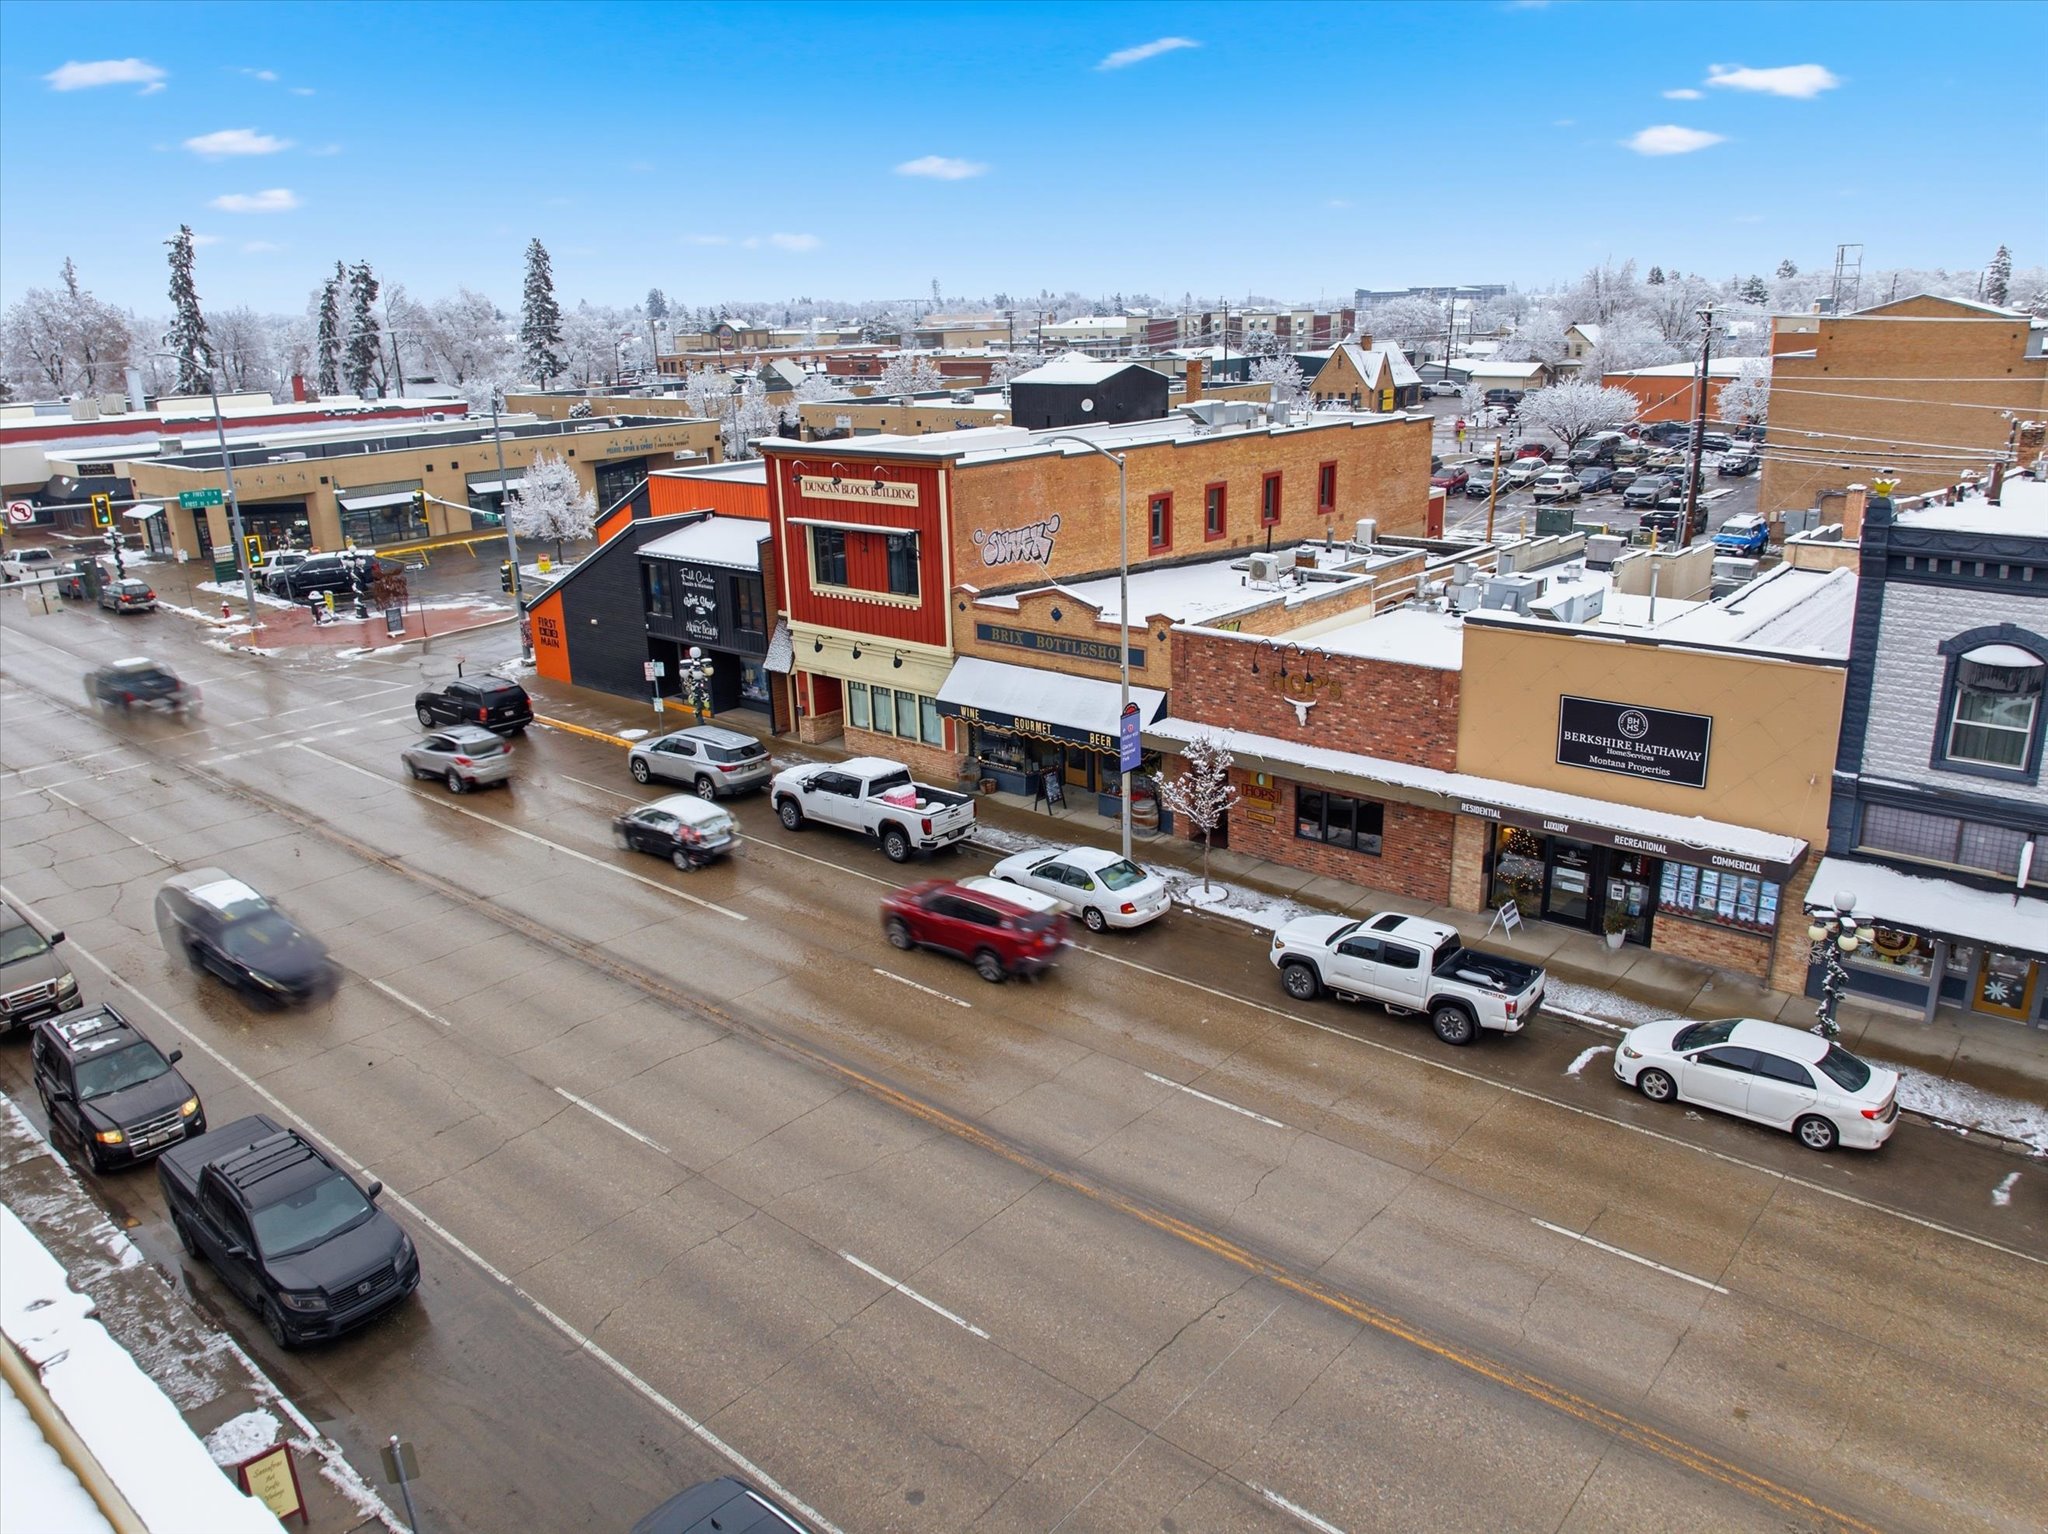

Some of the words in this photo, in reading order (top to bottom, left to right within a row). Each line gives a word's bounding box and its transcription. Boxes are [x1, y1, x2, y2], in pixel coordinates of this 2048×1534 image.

[804, 481, 840, 494] DUNCAN
[841, 484, 870, 498] BLOCK
[871, 487, 916, 500] BUILDING
[538, 616, 557, 629] FIRST
[540, 636, 560, 648] MAIN
[991, 627, 1024, 645] BRIX
[1035, 635, 1124, 661] BOTTLESHO
[961, 706, 980, 720] WINE
[1627, 716, 1640, 725] BH
[1014, 717, 1052, 734] GOURMET
[1626, 724, 1639, 732] HS
[1090, 733, 1112, 747] BEER
[1564, 731, 1632, 750] BERKSHIRE
[1635, 742, 1702, 762] HATHAWAY
[1606, 747, 1655, 762] HomeServices
[1589, 755, 1626, 769] Montana
[1627, 762, 1671, 776] Properties
[1461, 802, 1502, 819] RESIDENTIAL
[1543, 820, 1569, 833] LUXURY
[1614, 834, 1668, 855] RECREATIONAL
[1711, 855, 1762, 874] COMMERCIAL
